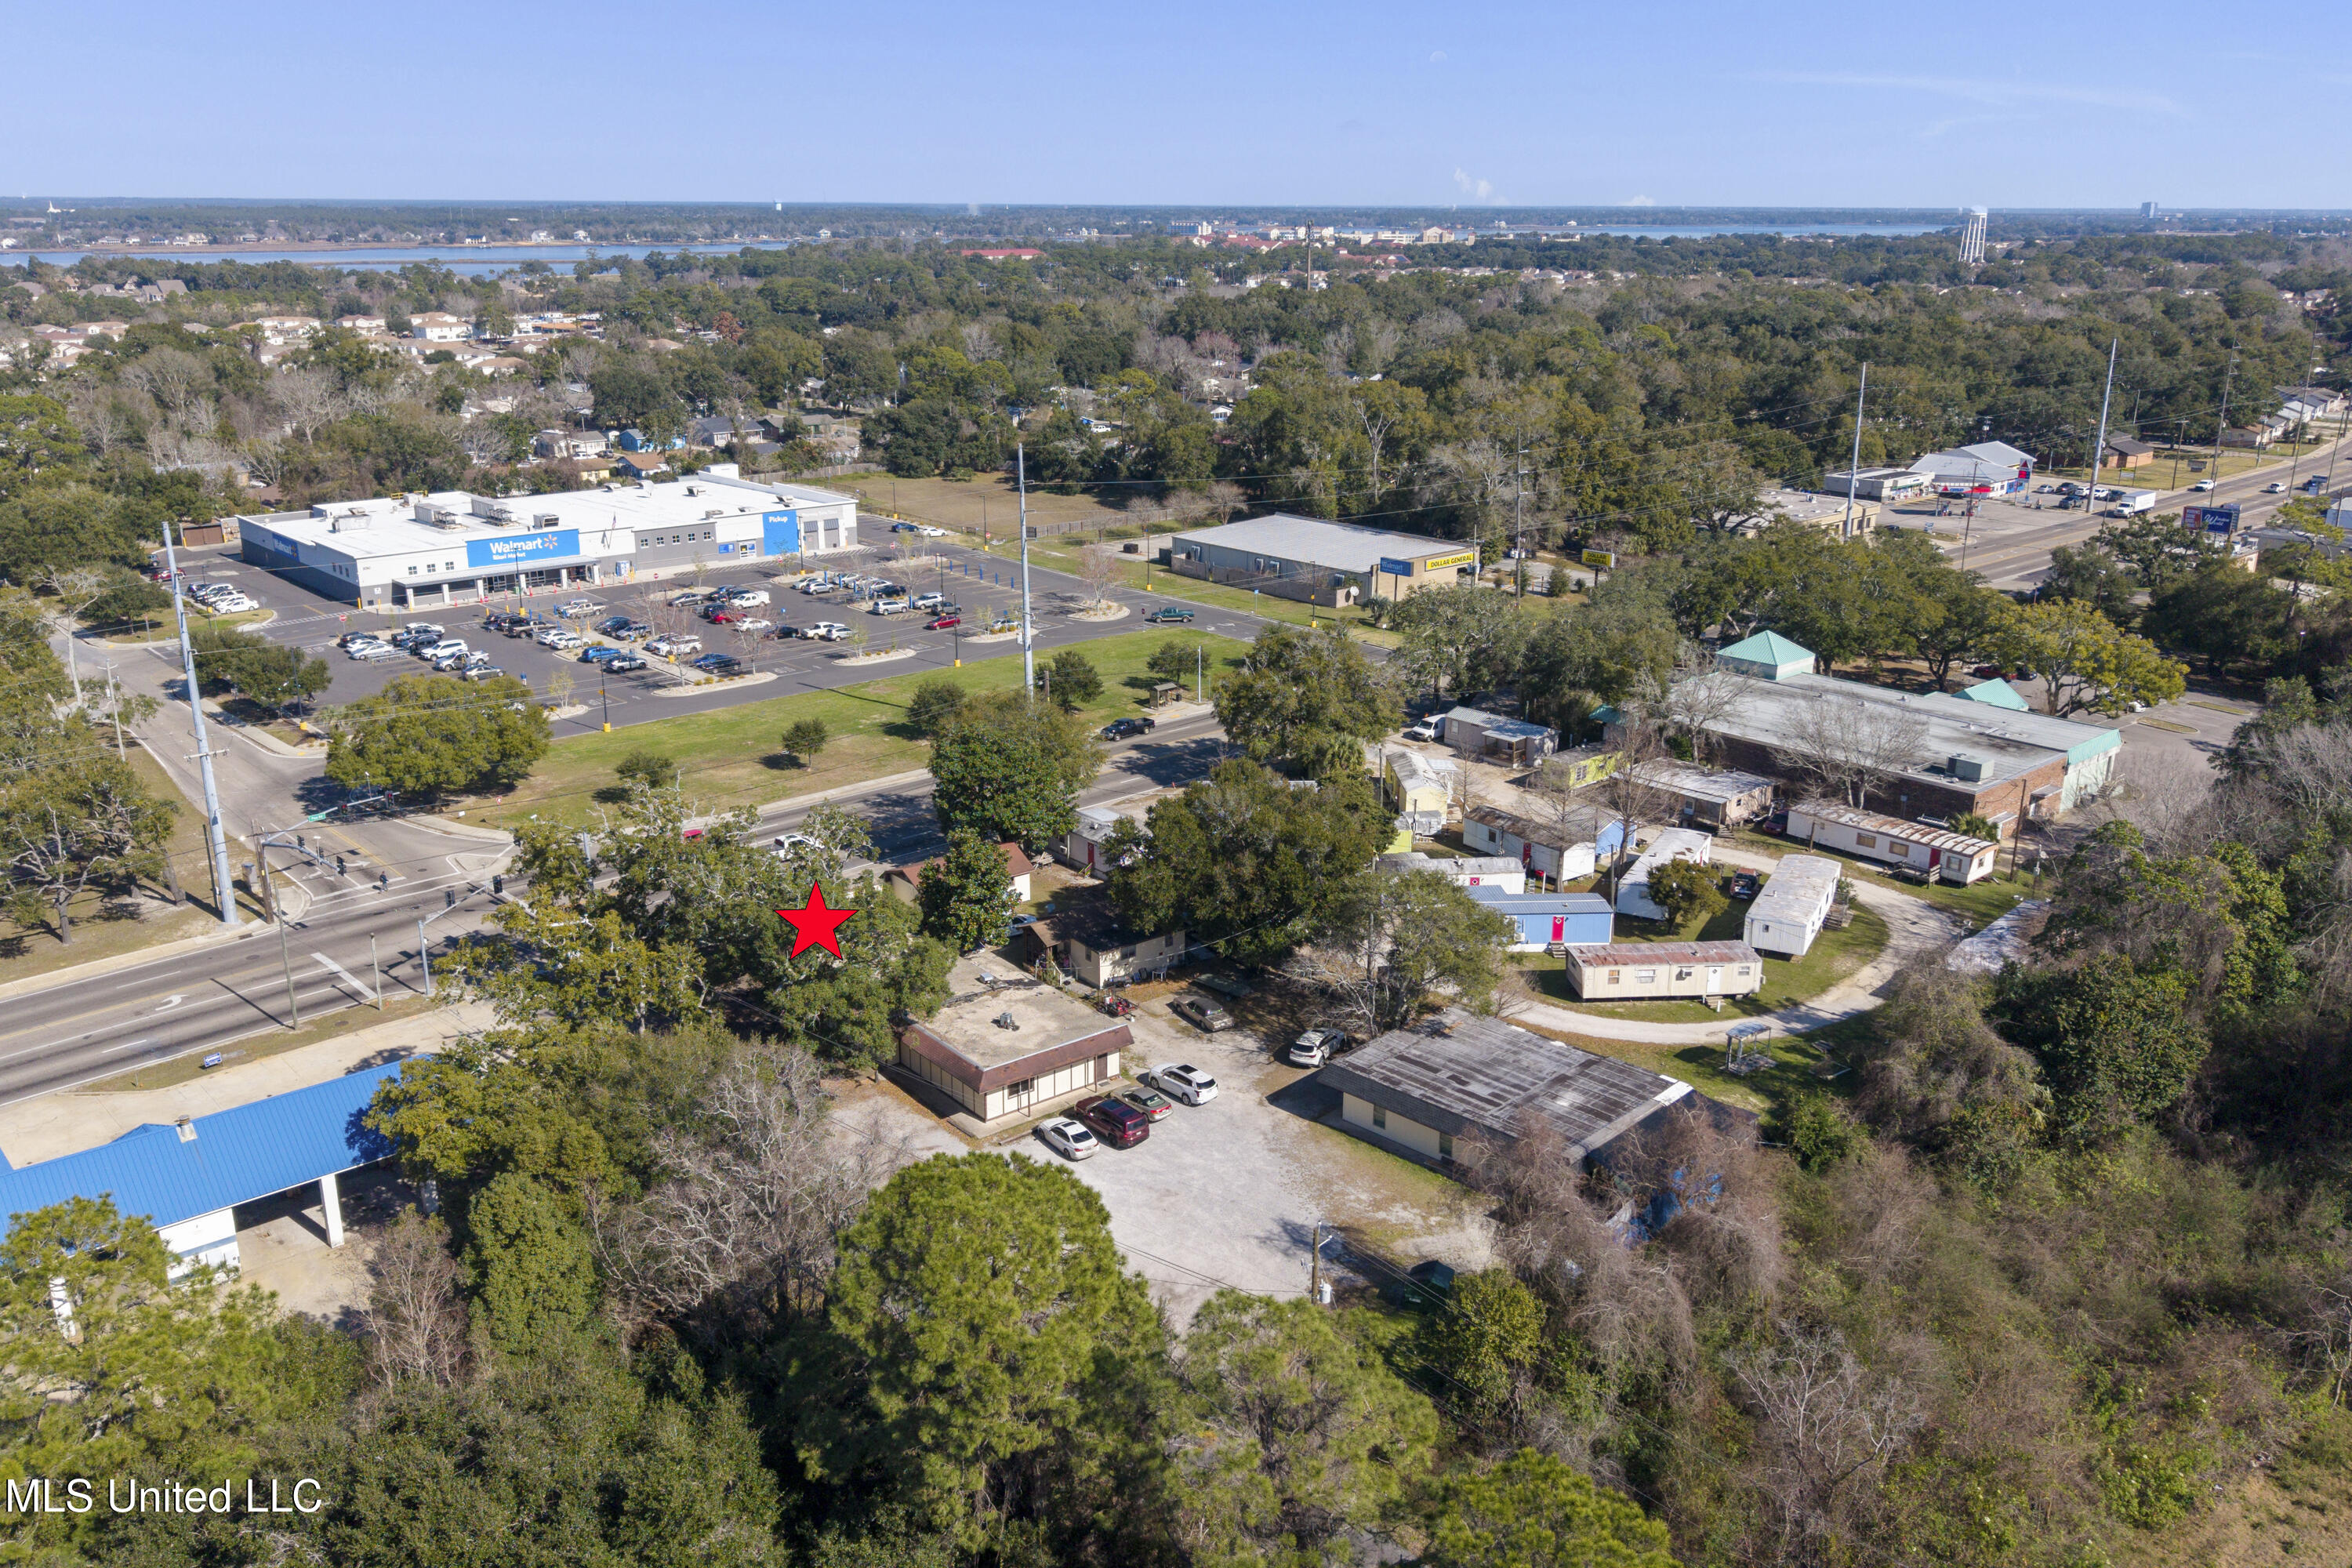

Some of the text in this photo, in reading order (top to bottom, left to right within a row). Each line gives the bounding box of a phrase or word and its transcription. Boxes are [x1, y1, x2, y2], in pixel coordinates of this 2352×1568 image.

[489, 537, 543, 554] Walmart
[1431, 554, 1472, 568] DOLLAR GENERAL
